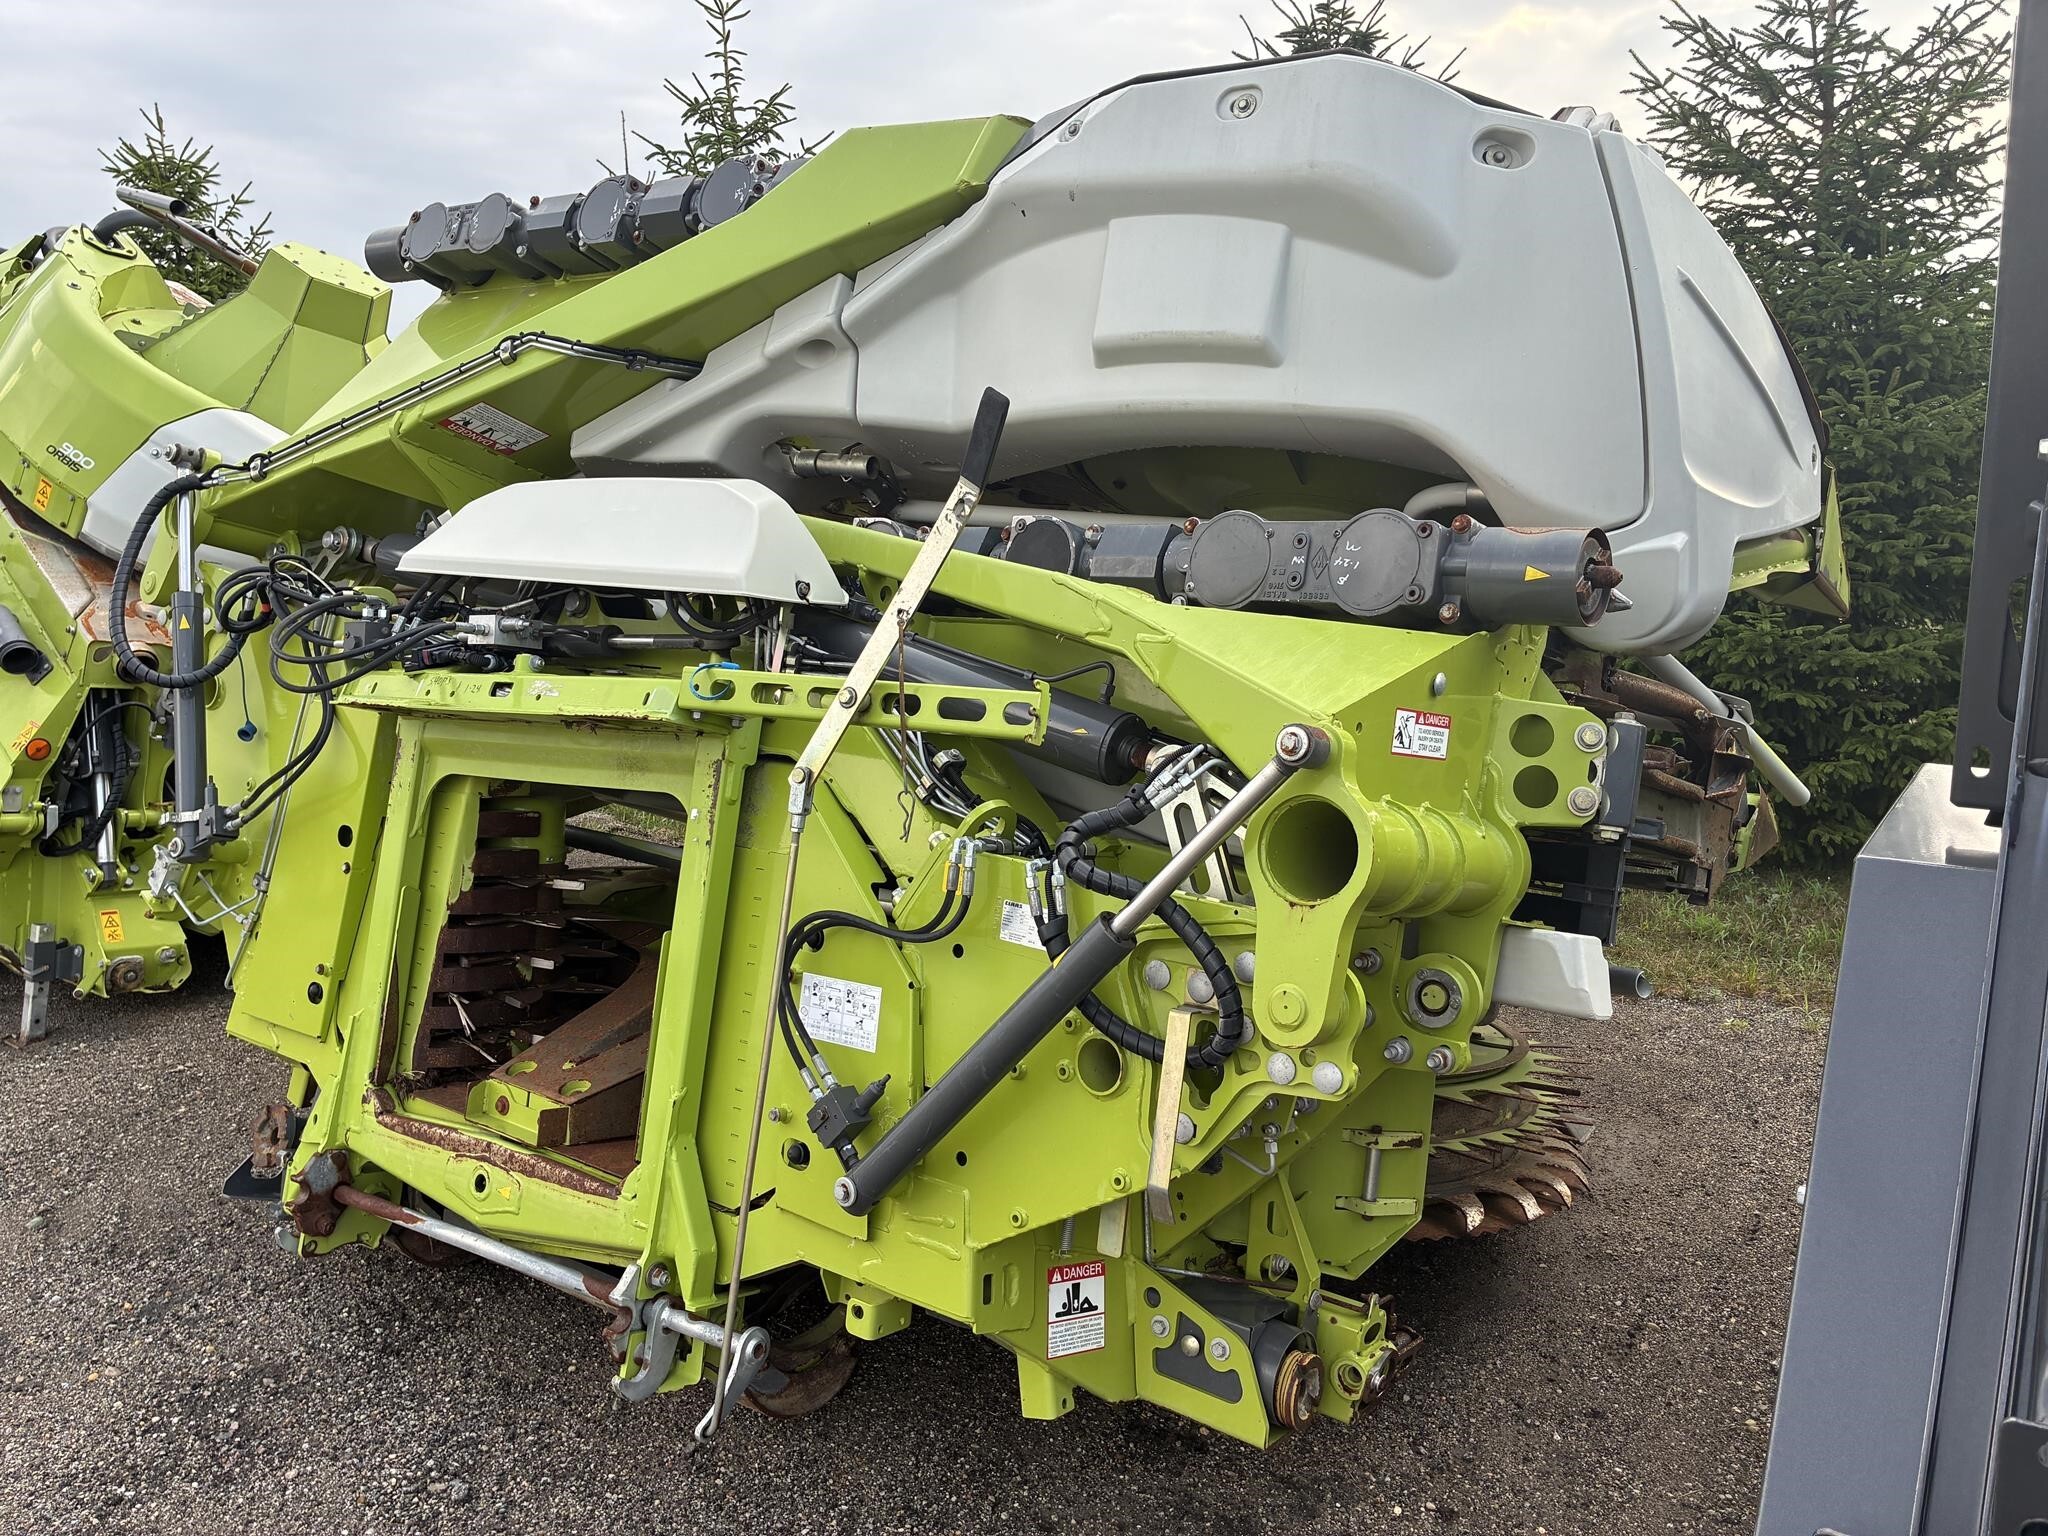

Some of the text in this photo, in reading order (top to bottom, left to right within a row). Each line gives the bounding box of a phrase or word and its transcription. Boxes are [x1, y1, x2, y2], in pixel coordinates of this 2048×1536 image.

[447, 423, 494, 446] DANGER
[46, 445, 83, 472] ORBIS
[59, 442, 95, 469] 900
[1426, 714, 1450, 727] DANGER
[1063, 1263, 1102, 1279] DANGER
